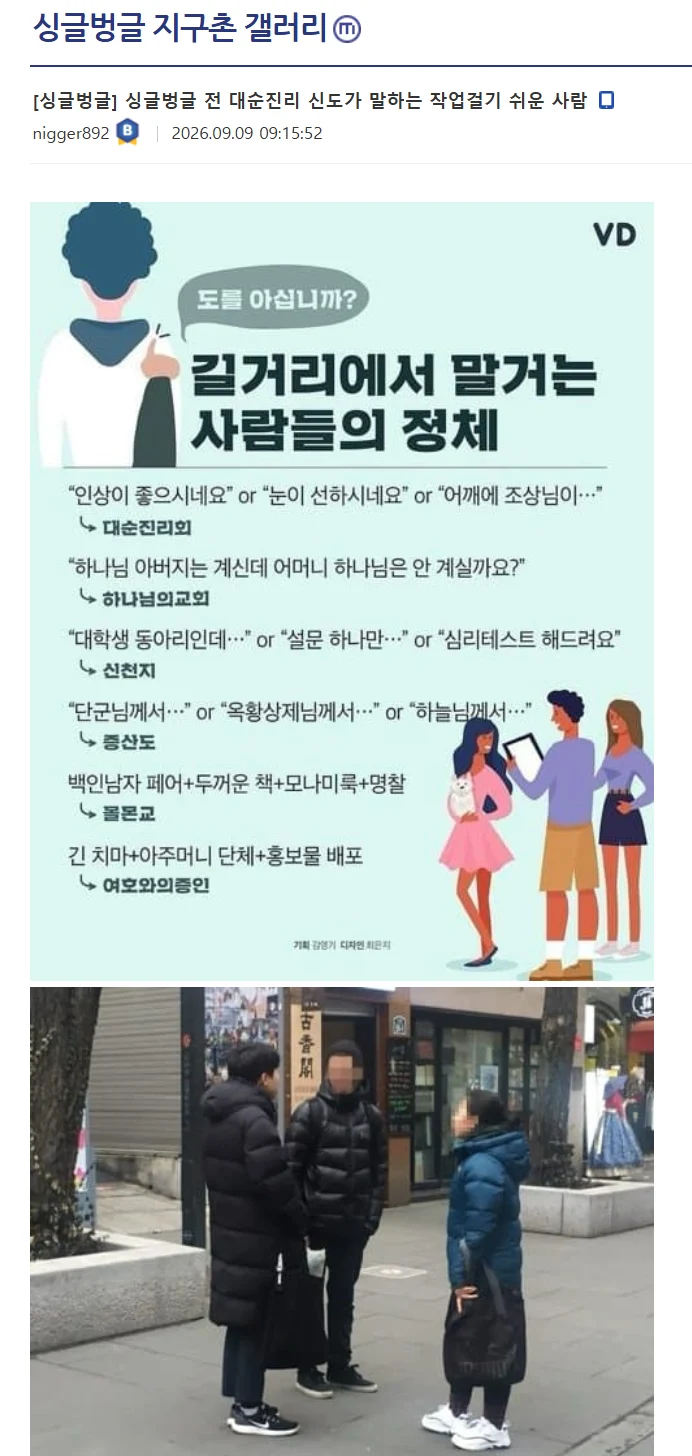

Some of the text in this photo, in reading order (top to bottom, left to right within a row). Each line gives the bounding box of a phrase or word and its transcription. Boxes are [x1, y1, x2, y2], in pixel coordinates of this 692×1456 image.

[593, 222, 636, 247] VD
[198, 289, 358, 310] 도를 아십니까?
[191, 353, 597, 397] 길거리에서 말거는
[191, 408, 498, 453] 사람들의 정체
[69, 485, 128, 506] “인상이
[135, 485, 233, 506] 좋으시네요”
[239, 491, 257, 504] or
[263, 485, 304, 506] “눈이
[311, 485, 408, 506] 선하시네요”
[414, 491, 433, 504] or
[438, 485, 498, 506] “어깨에
[103, 520, 191, 536] 대순진리회
[69, 557, 525, 578] “하나님 아버지는 계신데 어머니 하나님은 안 계실까요?”
[103, 591, 209, 607] 하나님의교회
[69, 629, 129, 650] “대학생
[257, 635, 275, 648] or
[281, 629, 323, 650] “설문
[414, 635, 432, 648] or
[438, 629, 536, 650] “심리테스트
[541, 629, 621, 650] 해드려요”
[103, 662, 155, 679] 신천지
[196, 707, 215, 720] or
[386, 707, 405, 720] or
[103, 734, 155, 751] 증산도
[69, 774, 406, 794] 백인남자 페어+두꺼운 책+모나미룩+명찰
[103, 806, 155, 822] 몰몬교
[69, 845, 363, 867] 긴 치마+아주머니 단체+홍보물 배포
[103, 878, 209, 894] 여호와의증인
[340, 940, 364, 951] 디자인
